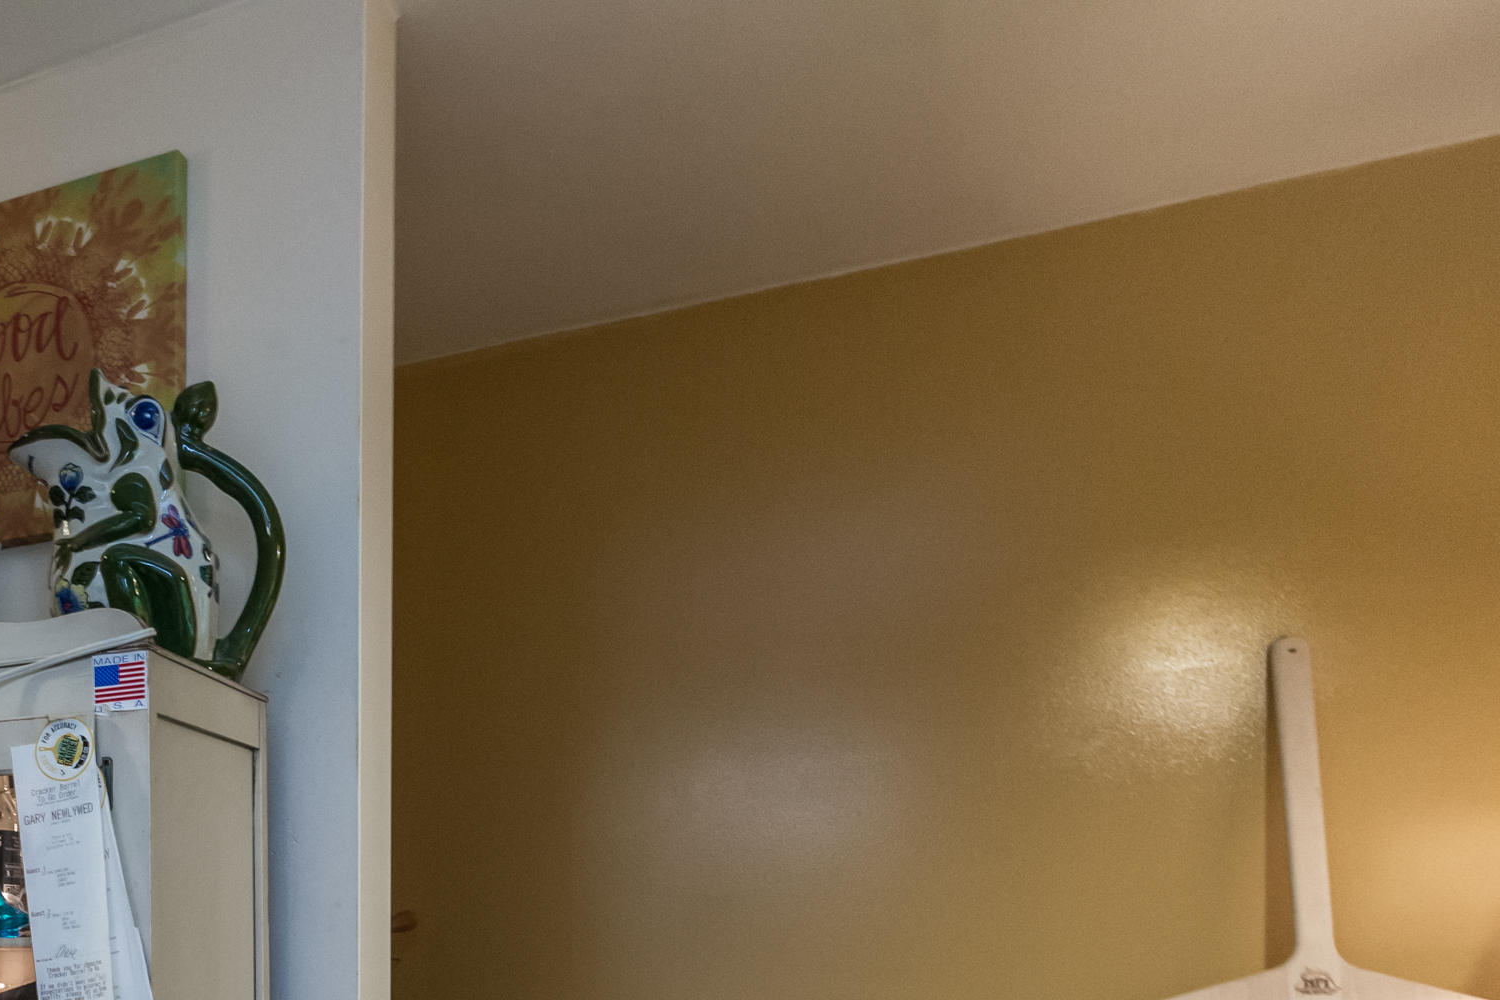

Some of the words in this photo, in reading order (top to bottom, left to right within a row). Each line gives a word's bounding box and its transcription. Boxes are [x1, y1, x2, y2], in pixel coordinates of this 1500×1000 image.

[93, 655, 129, 666] MADE
[132, 653, 145, 661] IN
[23, 812, 46, 826] GARY
[51, 802, 94, 821] NEWLYWED
